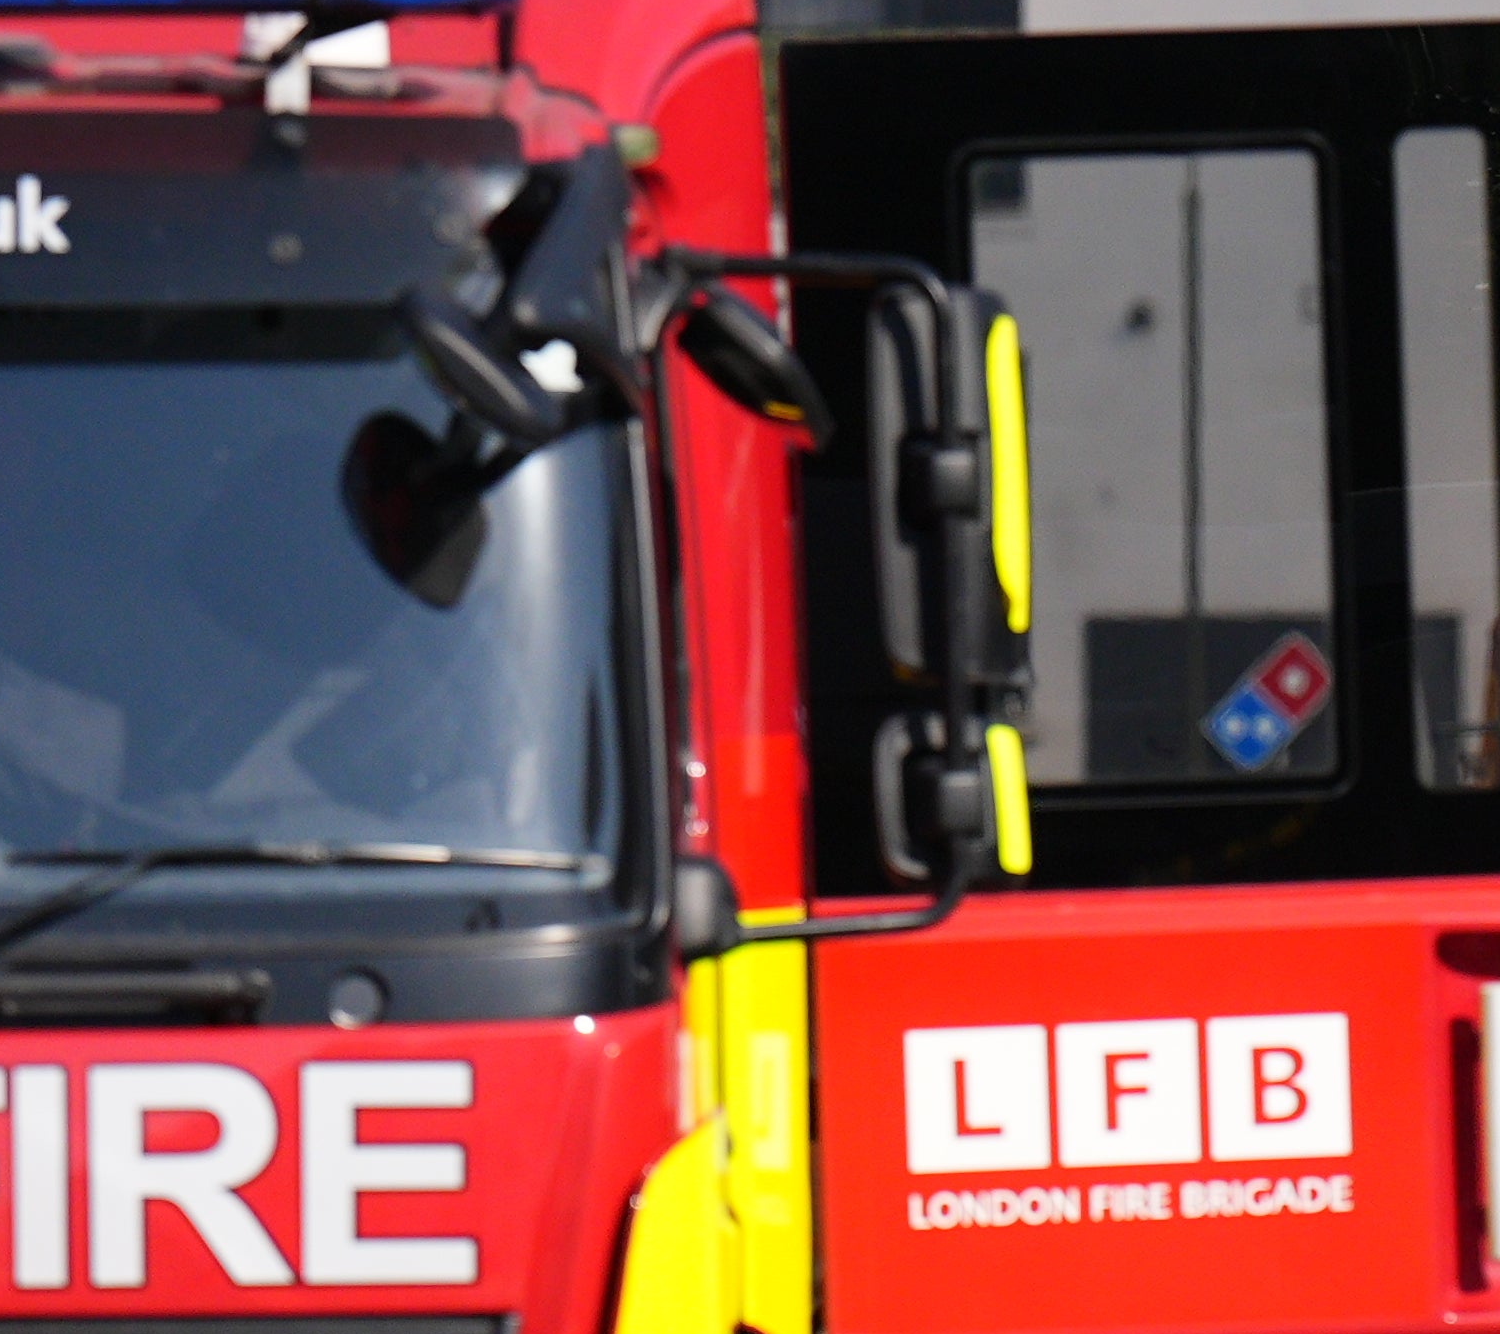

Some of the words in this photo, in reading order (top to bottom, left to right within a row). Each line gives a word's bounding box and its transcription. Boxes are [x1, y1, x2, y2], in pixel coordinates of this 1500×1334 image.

[906, 1185, 1082, 1231] LONDON
[1088, 1181, 1173, 1223] FIRE
[1179, 1174, 1355, 1220] BRIGADE
